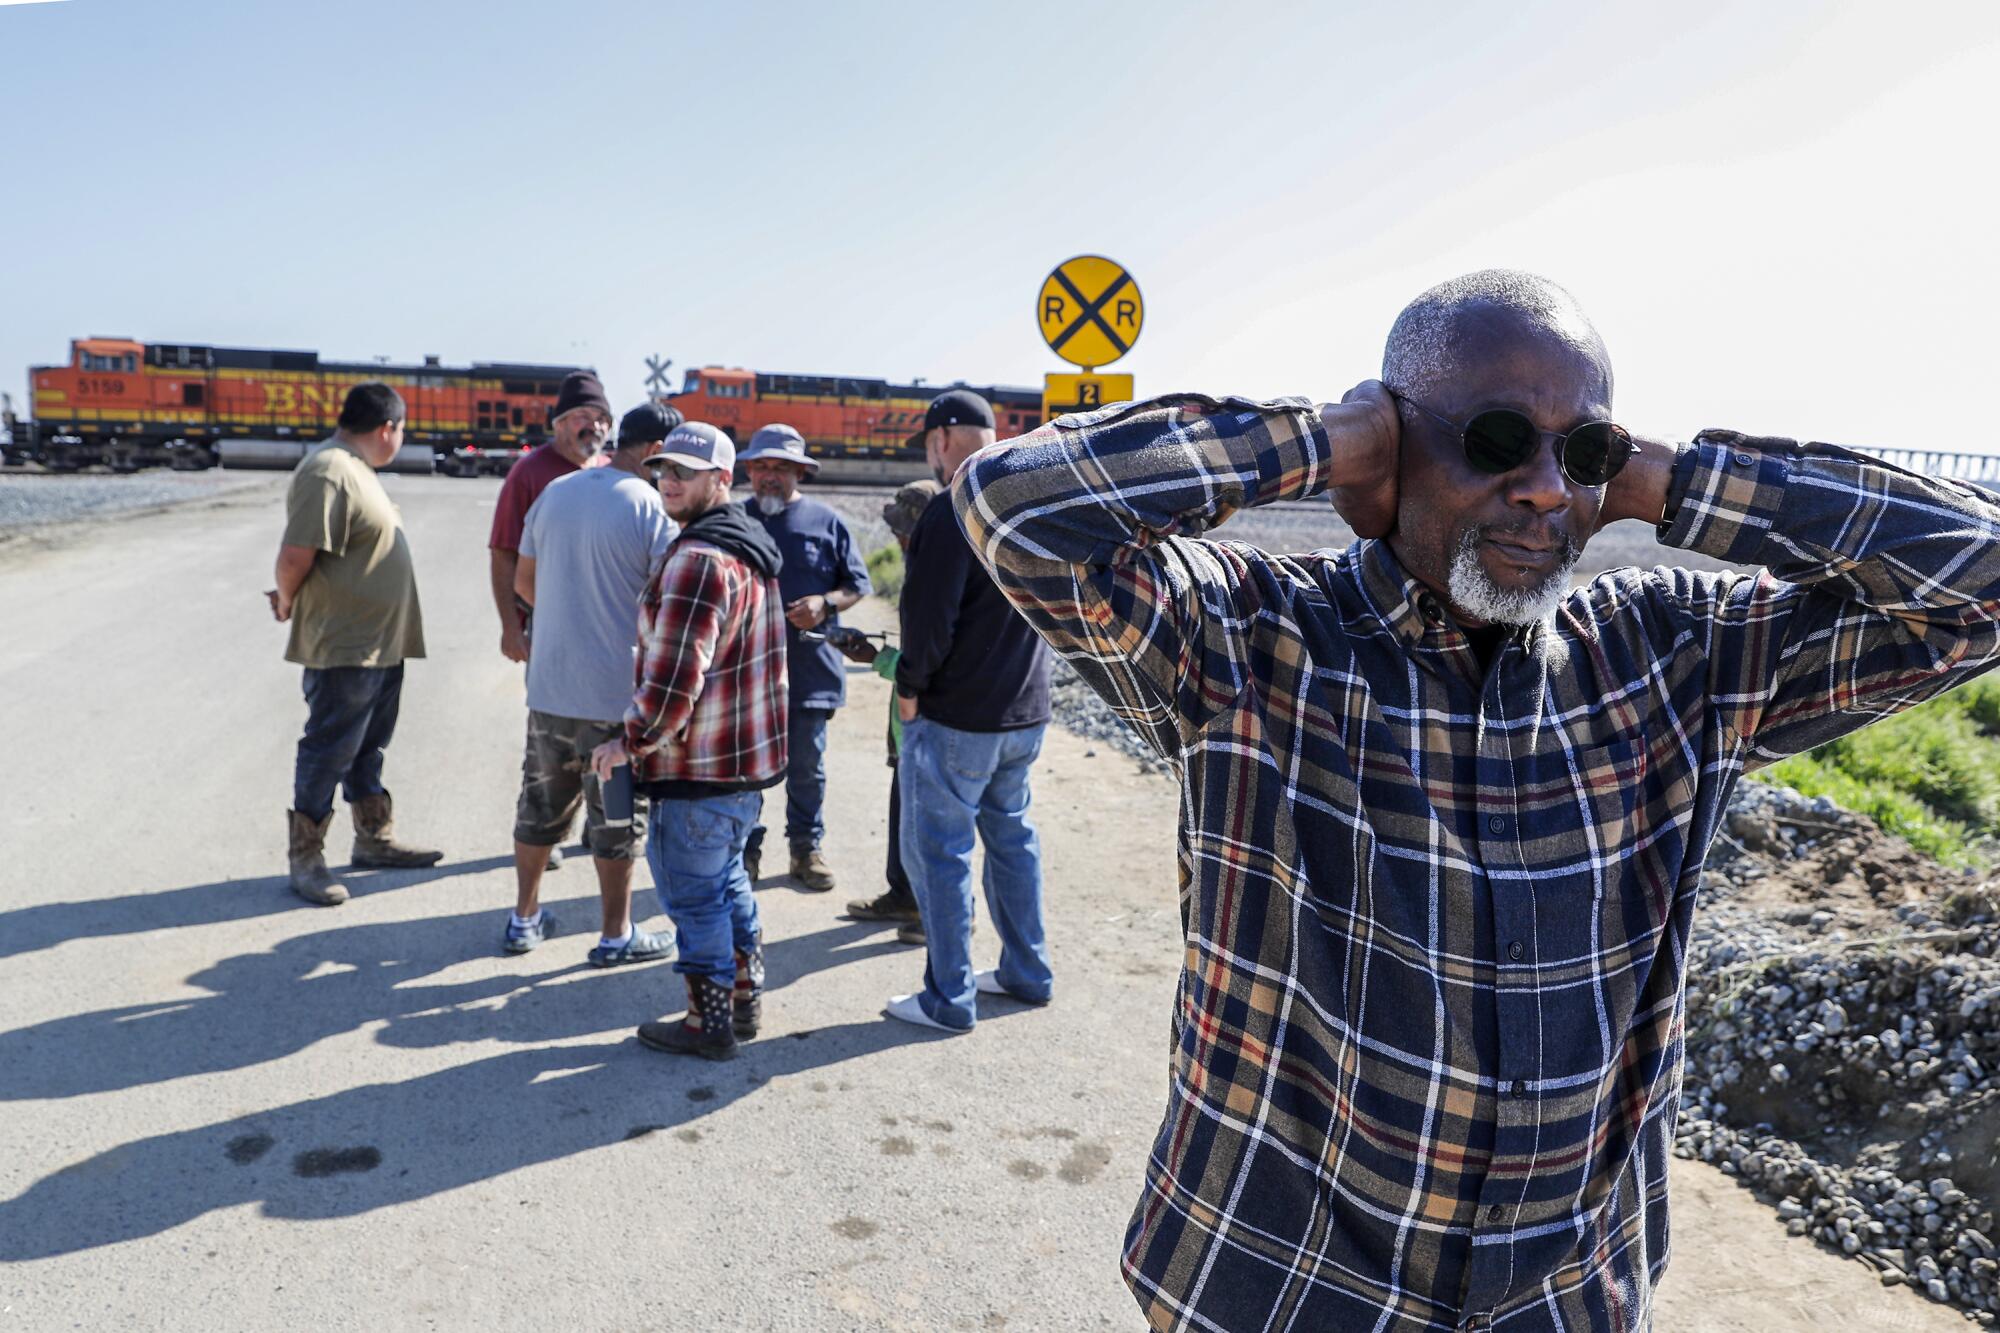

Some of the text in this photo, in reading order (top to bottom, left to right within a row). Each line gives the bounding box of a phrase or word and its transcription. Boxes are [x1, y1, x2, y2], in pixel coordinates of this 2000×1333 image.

[1044, 296, 1136, 327] R R
[1082, 384, 1096, 404] 2
